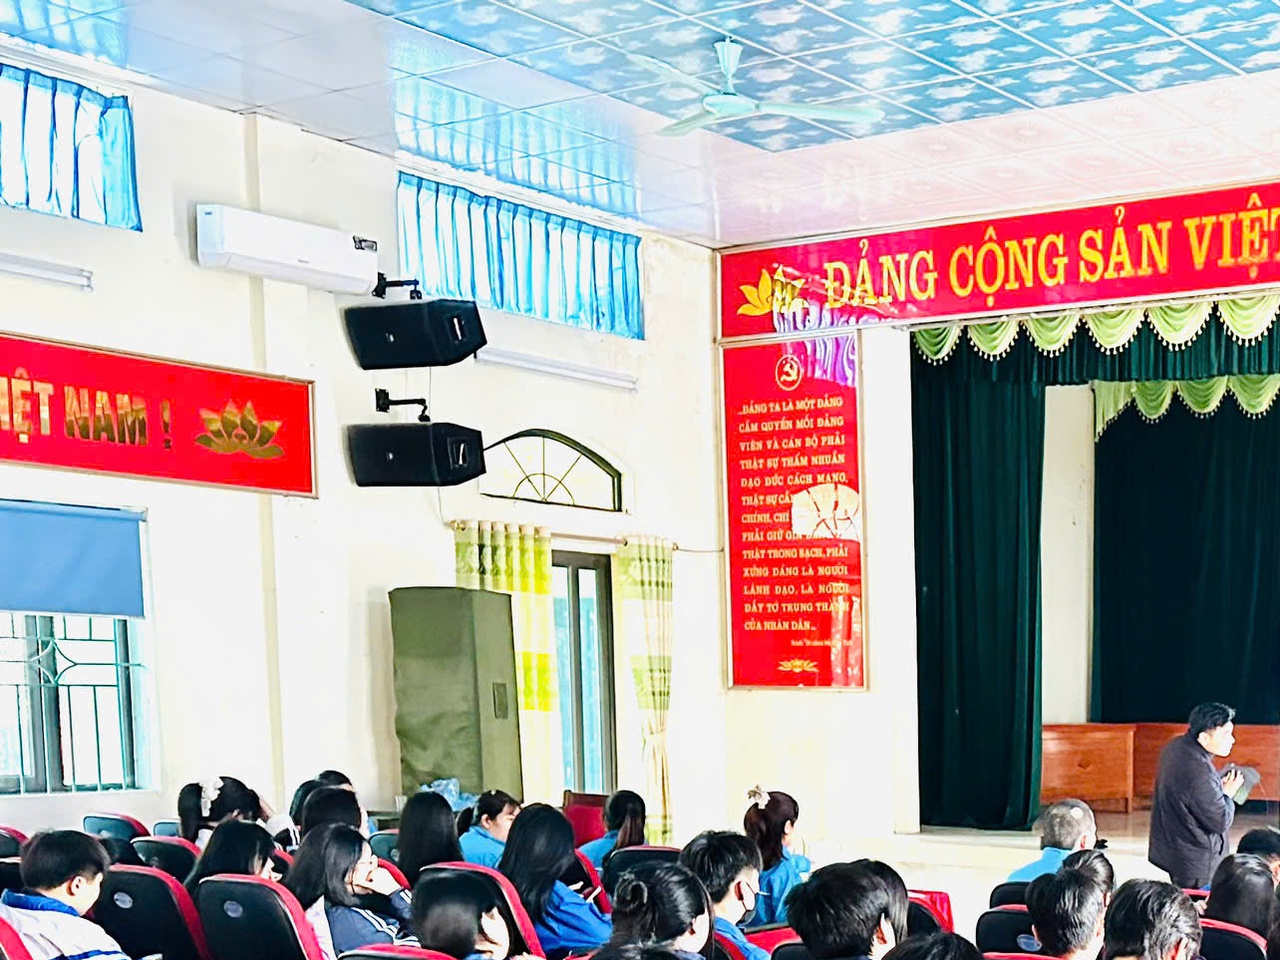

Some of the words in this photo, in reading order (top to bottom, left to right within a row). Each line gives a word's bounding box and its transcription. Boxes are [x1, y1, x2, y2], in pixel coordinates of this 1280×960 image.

[820, 235, 940, 312] ĐẢNG
[950, 227, 1069, 308] CỘNG
[1077, 204, 1172, 282] SẢN
[64, 386, 147, 446] NAM
